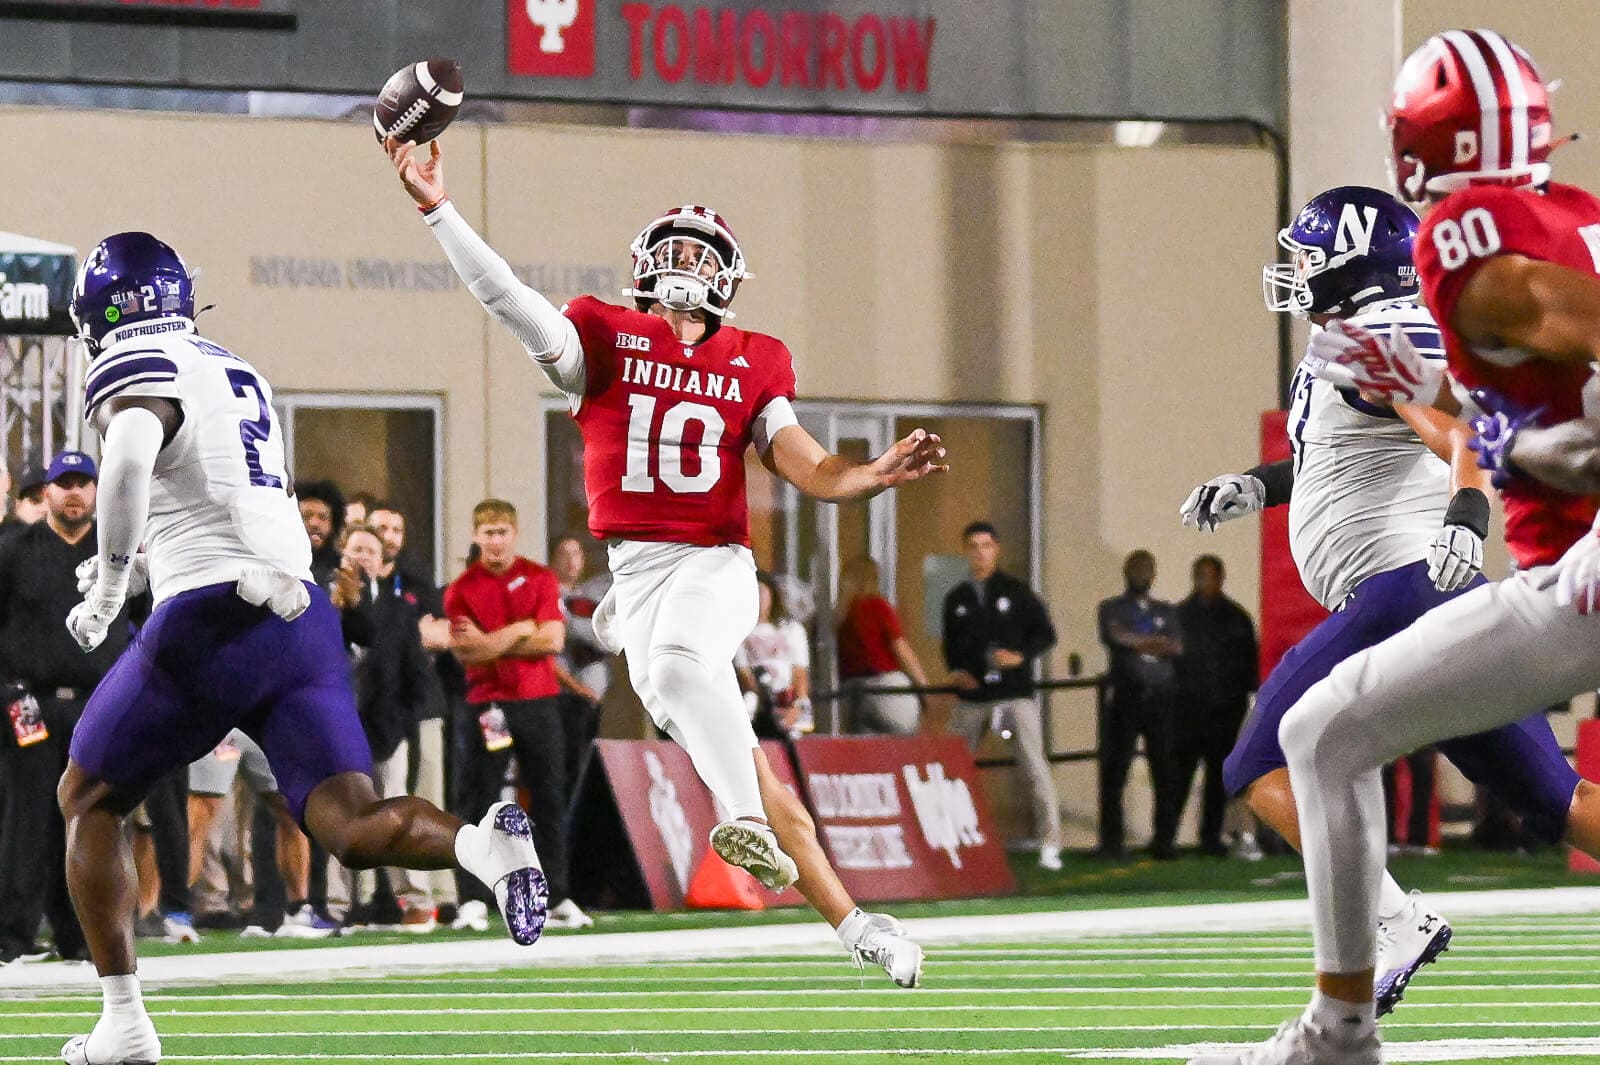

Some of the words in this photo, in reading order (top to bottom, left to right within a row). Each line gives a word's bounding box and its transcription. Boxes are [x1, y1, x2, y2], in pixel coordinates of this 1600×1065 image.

[621, 3, 937, 93] TOMORROW
[1334, 203, 1378, 256] N
[1432, 207, 1501, 270] 80
[141, 285, 158, 312] 2
[115, 320, 187, 343] NORTHWESTERN
[621, 357, 743, 403] INDIANA
[224, 367, 284, 490] 2
[621, 393, 726, 493] 10
